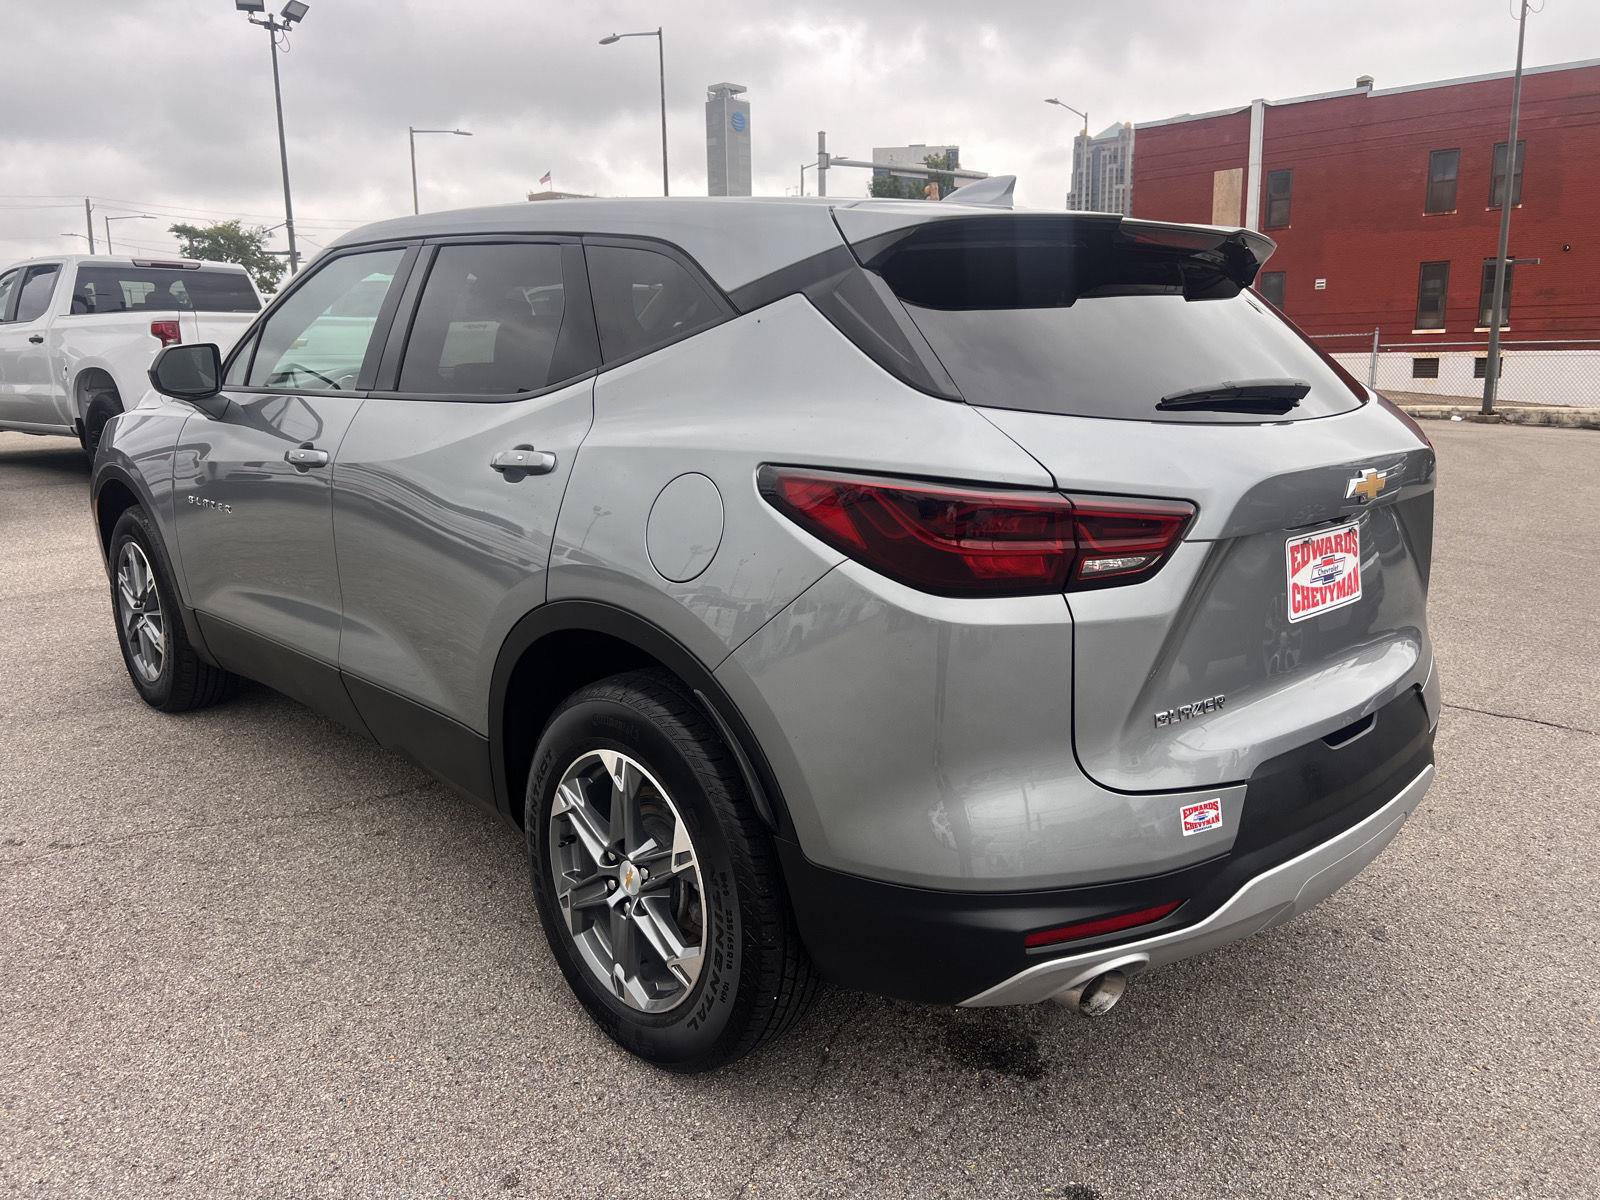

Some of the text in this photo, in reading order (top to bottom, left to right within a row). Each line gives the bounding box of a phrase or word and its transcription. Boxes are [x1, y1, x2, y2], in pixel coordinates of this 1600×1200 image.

[188, 495, 232, 514] BLAZER
[1290, 528, 1358, 578] EDWARDS
[1317, 564, 1340, 576] Chevrolet
[1291, 562, 1360, 614] CHEVYMAN
[1154, 694, 1226, 729] BLAZER
[1183, 800, 1219, 820] EDWARDS
[1184, 813, 1220, 831] CHEVYMAN
